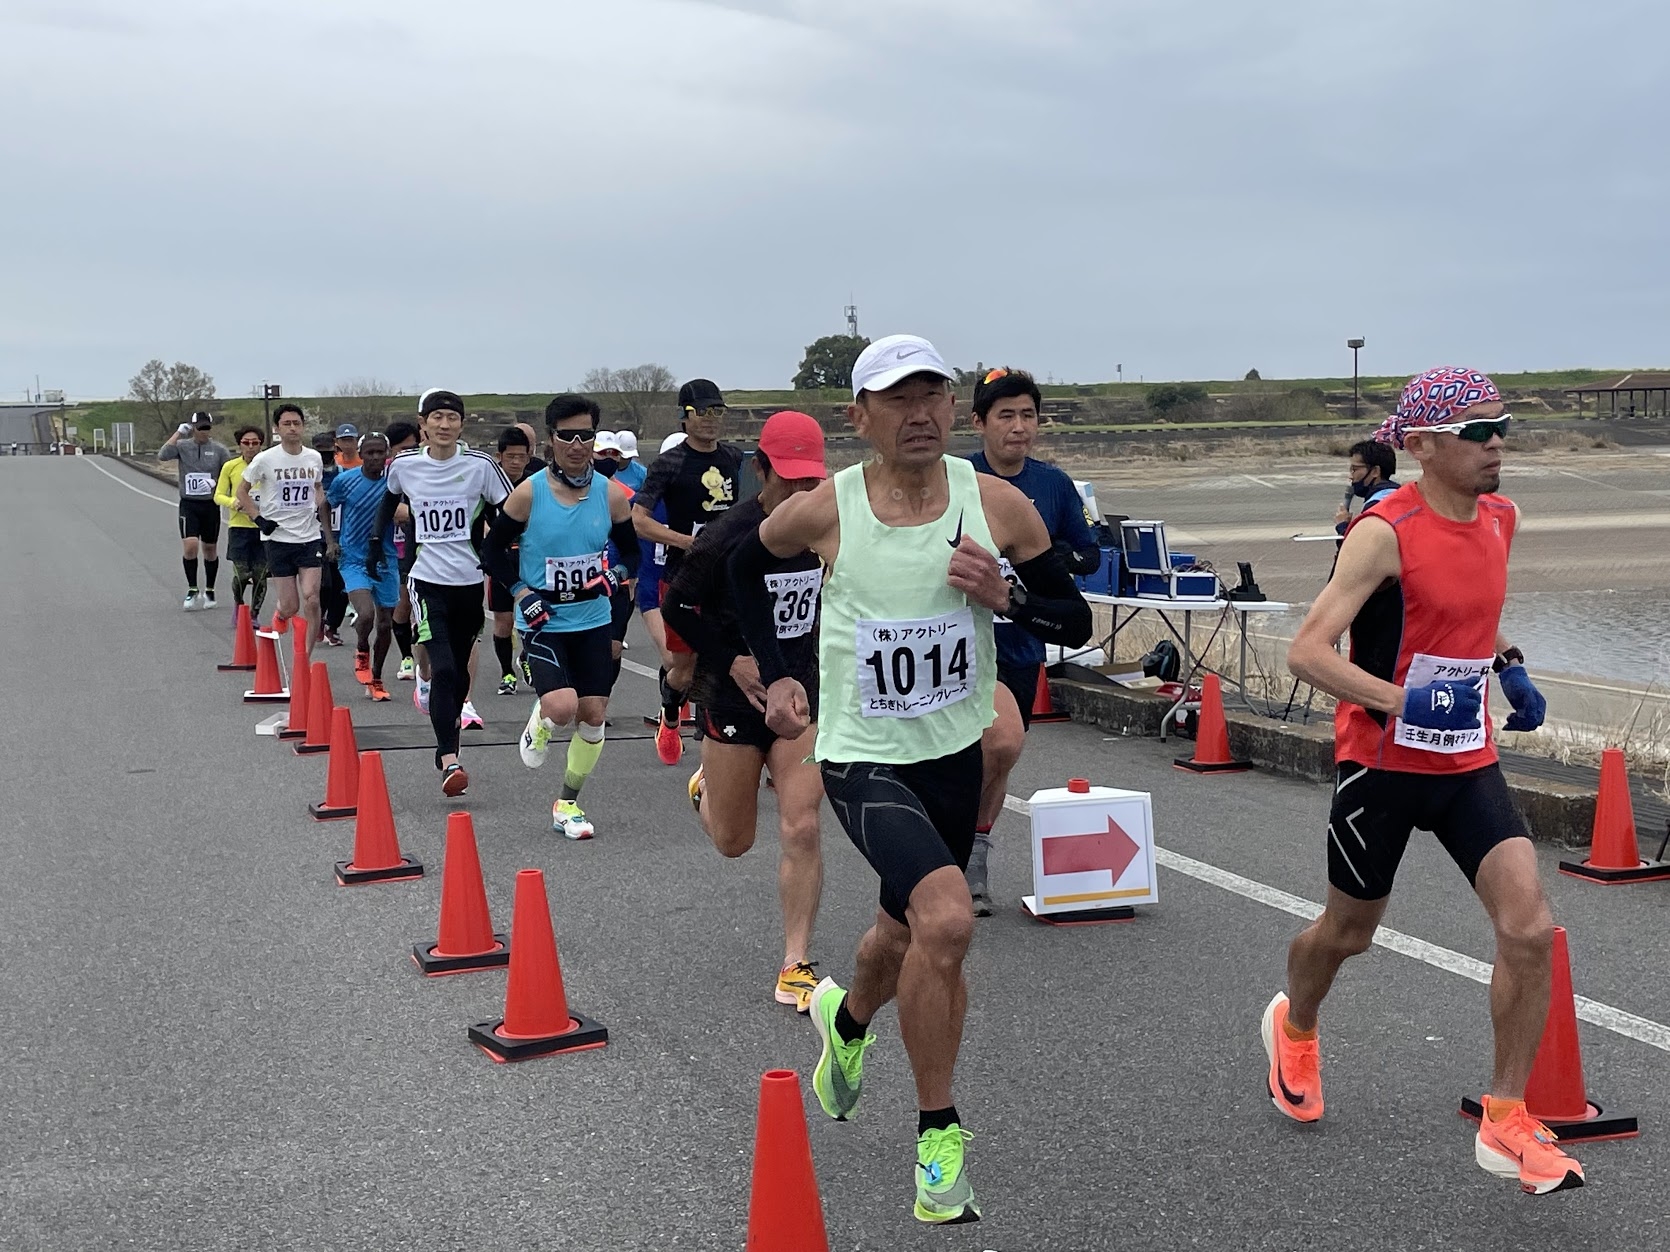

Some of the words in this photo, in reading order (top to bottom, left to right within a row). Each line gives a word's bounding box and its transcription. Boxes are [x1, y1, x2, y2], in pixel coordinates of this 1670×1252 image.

[282, 485, 309, 502] 878
[419, 507, 466, 533] 1020
[872, 622, 958, 642] （株）アクトリー
[865, 637, 969, 696] 1014
[870, 682, 968, 712] とちぎトレーニングレース
